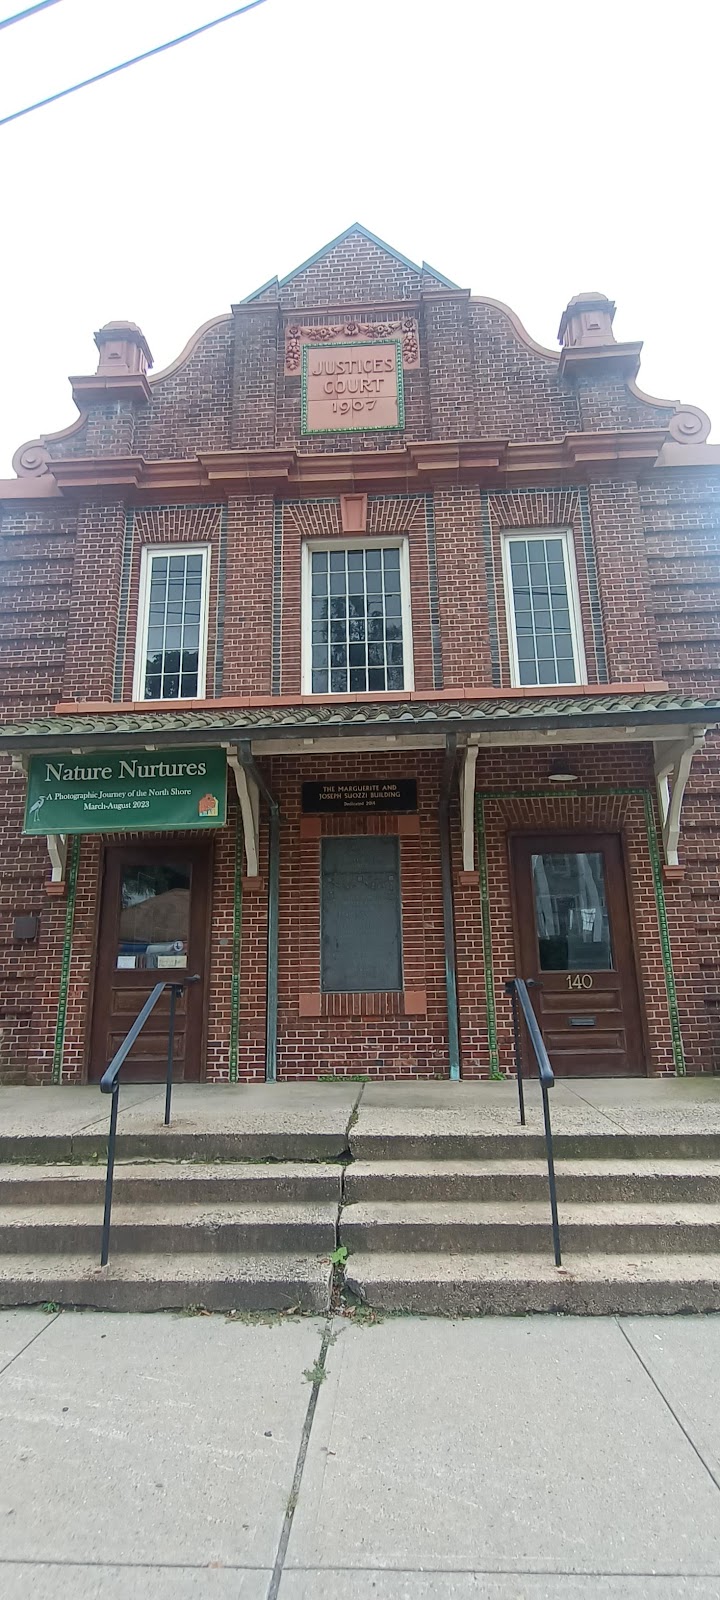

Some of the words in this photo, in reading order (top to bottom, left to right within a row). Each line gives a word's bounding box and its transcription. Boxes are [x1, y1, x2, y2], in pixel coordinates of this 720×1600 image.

[312, 359, 394, 376] JUSTICES
[324, 379, 384, 394] COURT
[332, 400, 377, 415] 1907
[45, 763, 113, 782] Nature
[118, 760, 207, 779] Nurtures
[54, 790, 98, 802] Photographic
[98, 790, 127, 800] Journey
[127, 789, 136, 797] of
[136, 789, 147, 797] the
[148, 788, 170, 797] North
[170, 787, 192, 796] Shore
[83, 802, 132, 811] March-August
[132, 800, 150, 809] 2023
[566, 974, 593, 989] 140
